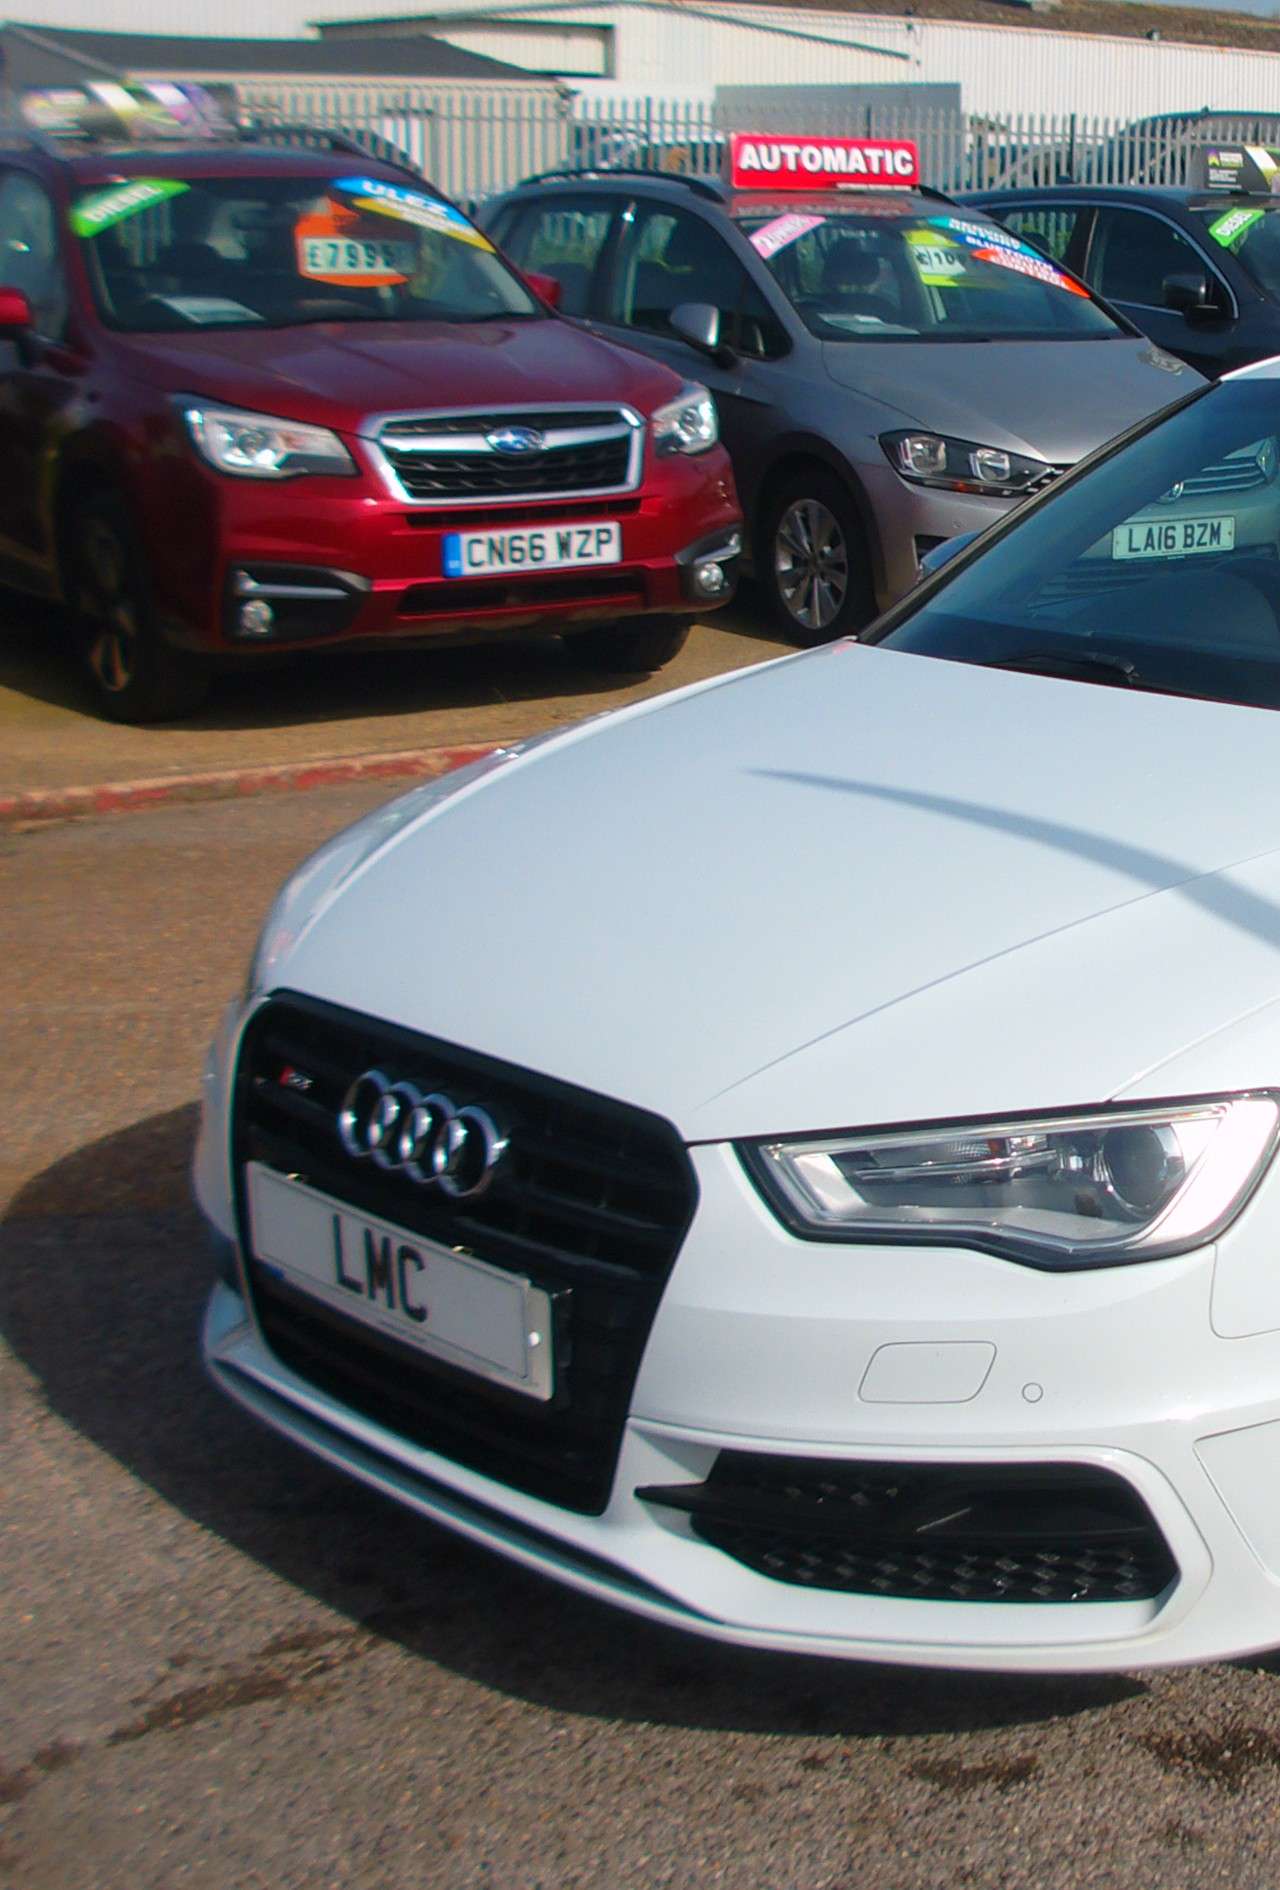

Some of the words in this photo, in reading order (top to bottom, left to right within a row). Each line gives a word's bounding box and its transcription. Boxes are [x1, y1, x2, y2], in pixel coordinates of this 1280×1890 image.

[738, 143, 915, 176] AUTOMATIC
[466, 533, 546, 568] CN66
[556, 528, 613, 561] WZP
[1128, 525, 1177, 552] LA16
[1182, 521, 1222, 548] BZM
[332, 1213, 428, 1323] LMC
